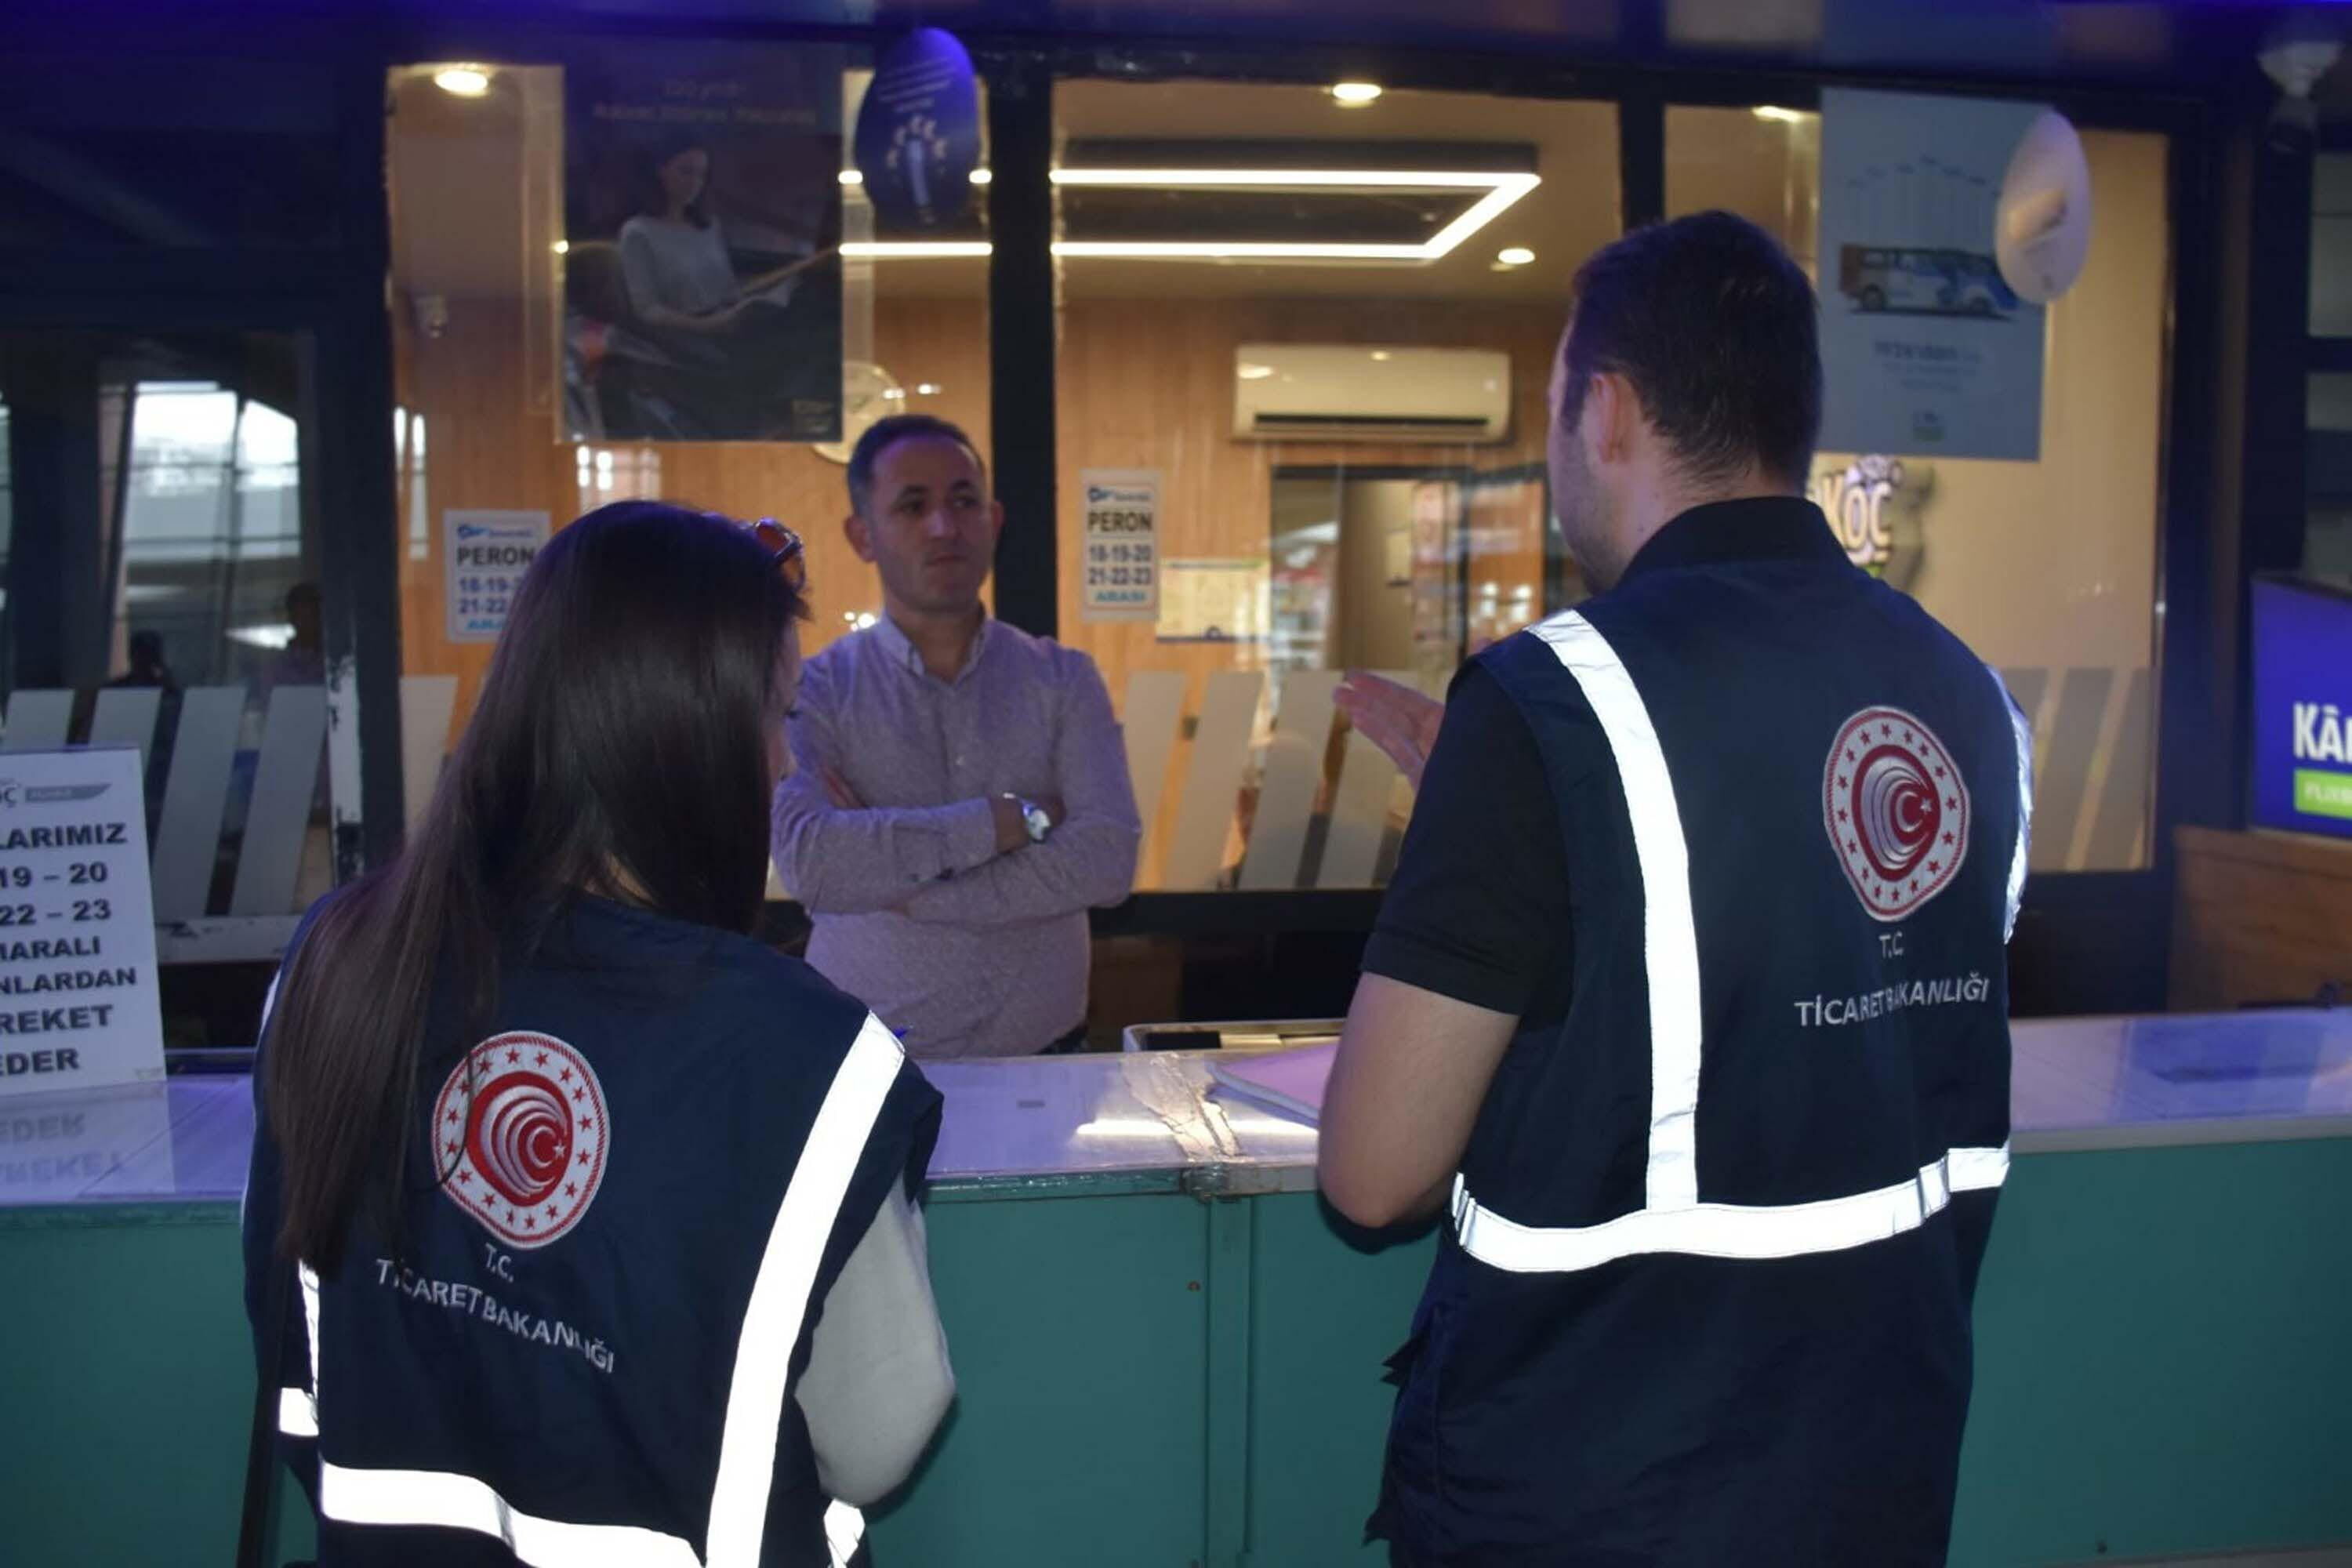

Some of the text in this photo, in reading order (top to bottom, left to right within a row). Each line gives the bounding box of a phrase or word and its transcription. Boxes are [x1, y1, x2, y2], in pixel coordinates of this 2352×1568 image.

[1087, 511, 1152, 532] PERON
[456, 546, 535, 566] PERON
[69, 862, 108, 884] 20
[0, 904, 36, 926] 22
[73, 899, 111, 921] 23
[1793, 989, 1885, 1027] TİCARET
[0, 1048, 79, 1076] DER
[484, 1242, 514, 1283] T.C.
[482, 1294, 615, 1374] BAKANLIĞI
